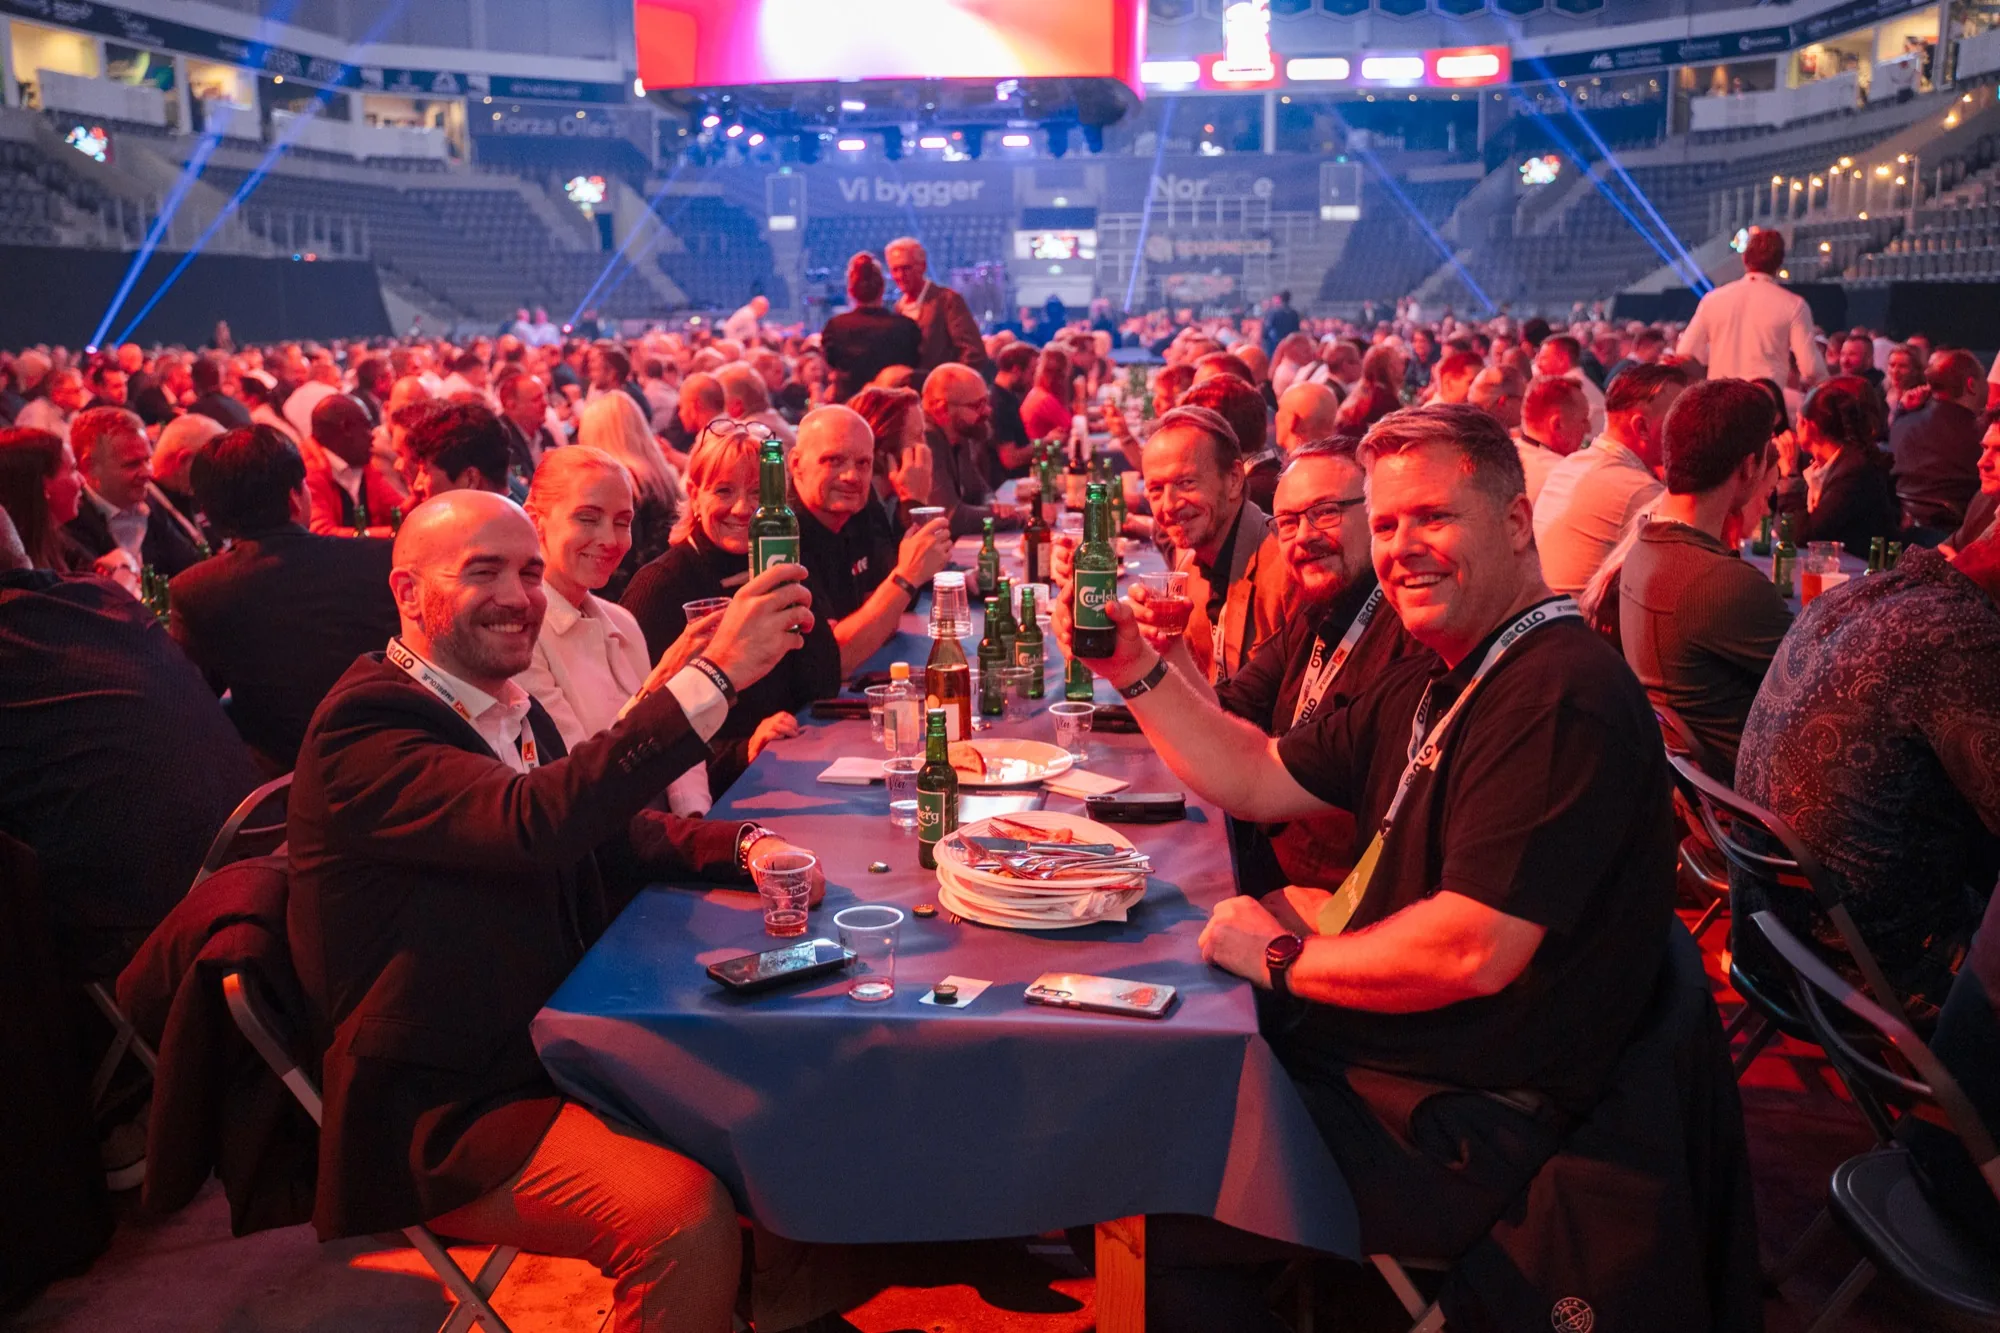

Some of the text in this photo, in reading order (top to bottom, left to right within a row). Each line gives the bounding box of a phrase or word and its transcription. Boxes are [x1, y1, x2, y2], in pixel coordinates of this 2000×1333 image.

[838, 176, 985, 208] Vi bygger
[1514, 610, 1546, 636] OTD
[391, 648, 415, 671] OTD
[697, 659, 729, 692] SURFACE
